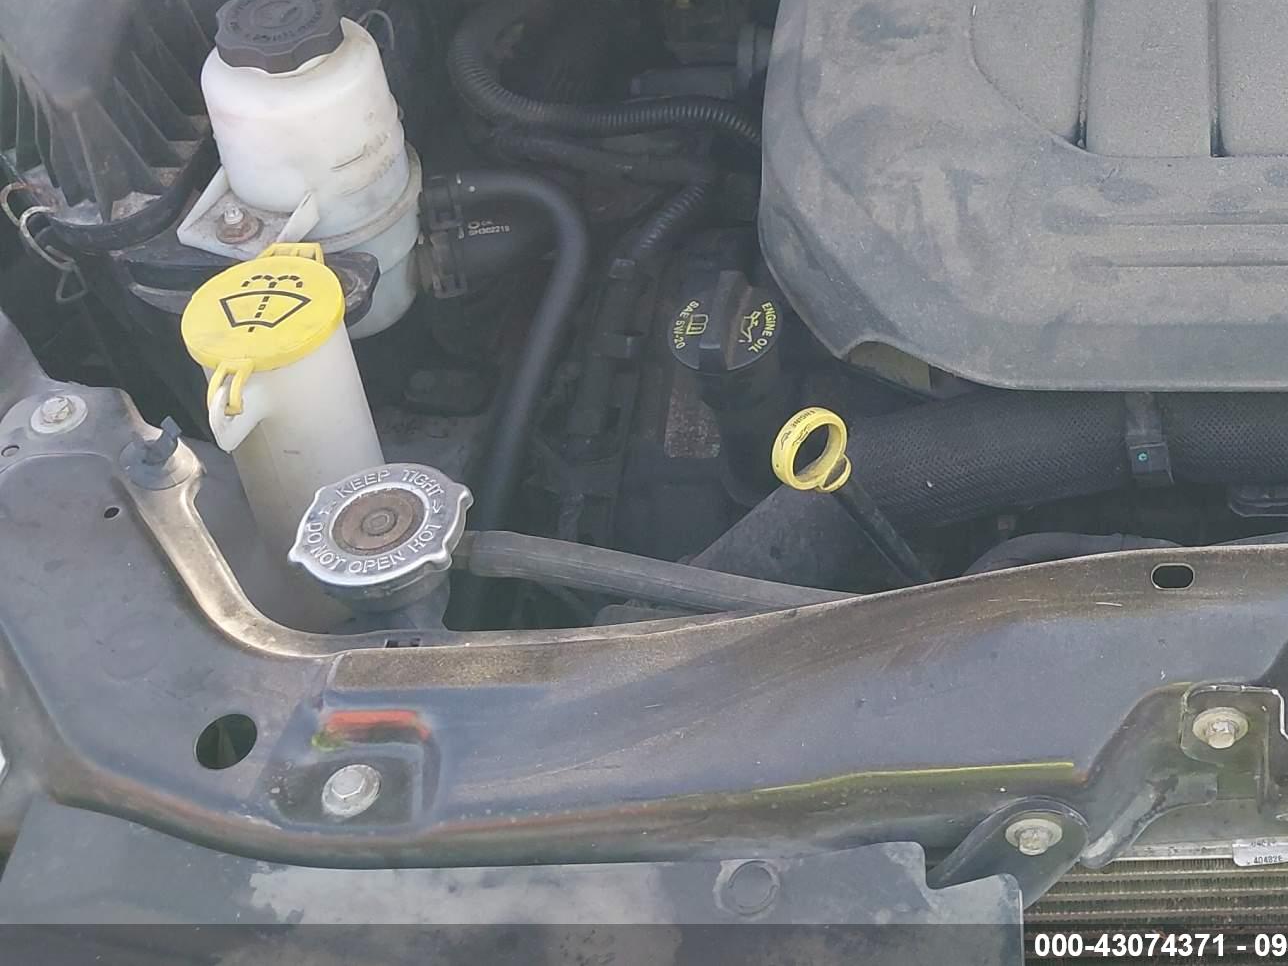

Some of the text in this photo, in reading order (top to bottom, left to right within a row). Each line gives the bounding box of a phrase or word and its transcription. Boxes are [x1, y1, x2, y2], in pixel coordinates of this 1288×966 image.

[679, 300, 700, 318] SAE
[747, 301, 778, 353] ENGINE OIL
[335, 468, 445, 499] KEEP TIGHT
[304, 520, 442, 574] DO NOT OPEN HOT
